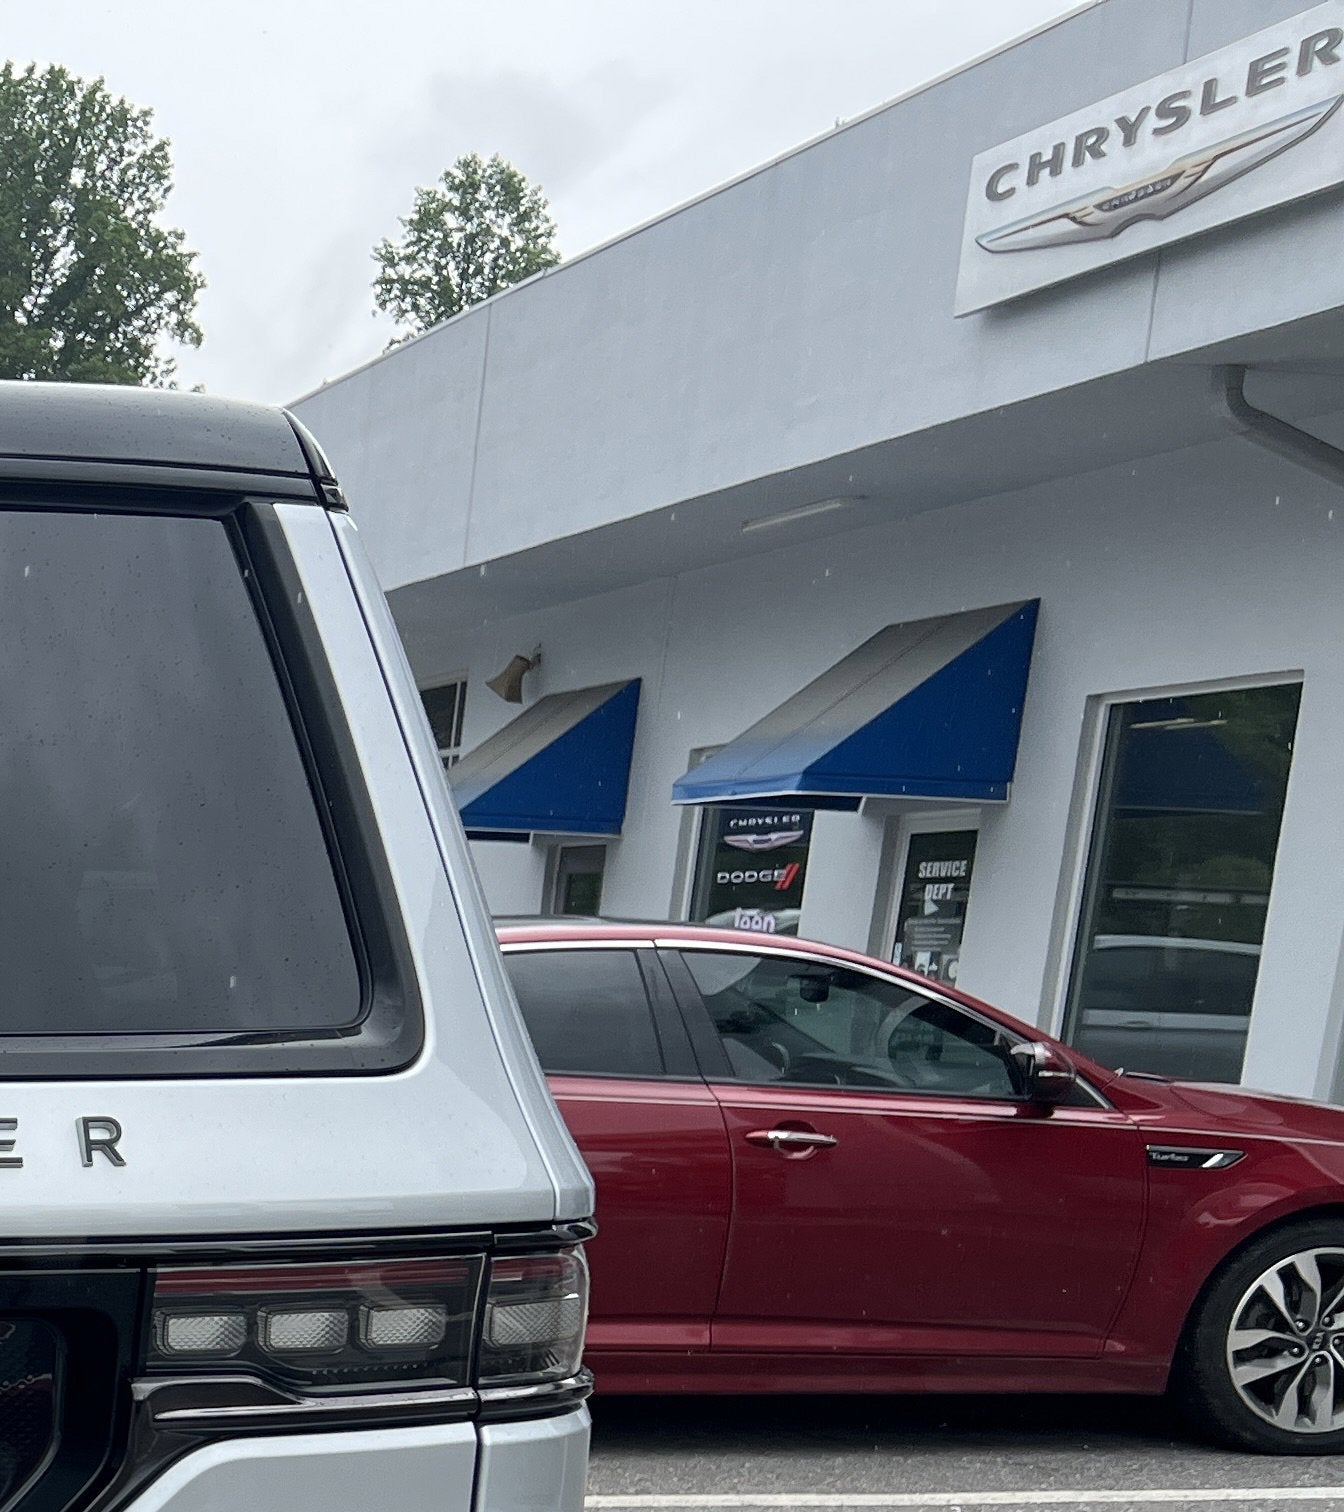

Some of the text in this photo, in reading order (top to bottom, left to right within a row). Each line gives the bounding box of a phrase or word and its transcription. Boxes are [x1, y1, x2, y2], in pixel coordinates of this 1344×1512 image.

[985, 27, 1344, 202] CHRYSLER
[717, 869, 787, 884] DODGE
[918, 860, 967, 879] SERVICE
[925, 883, 955, 900] DEPT
